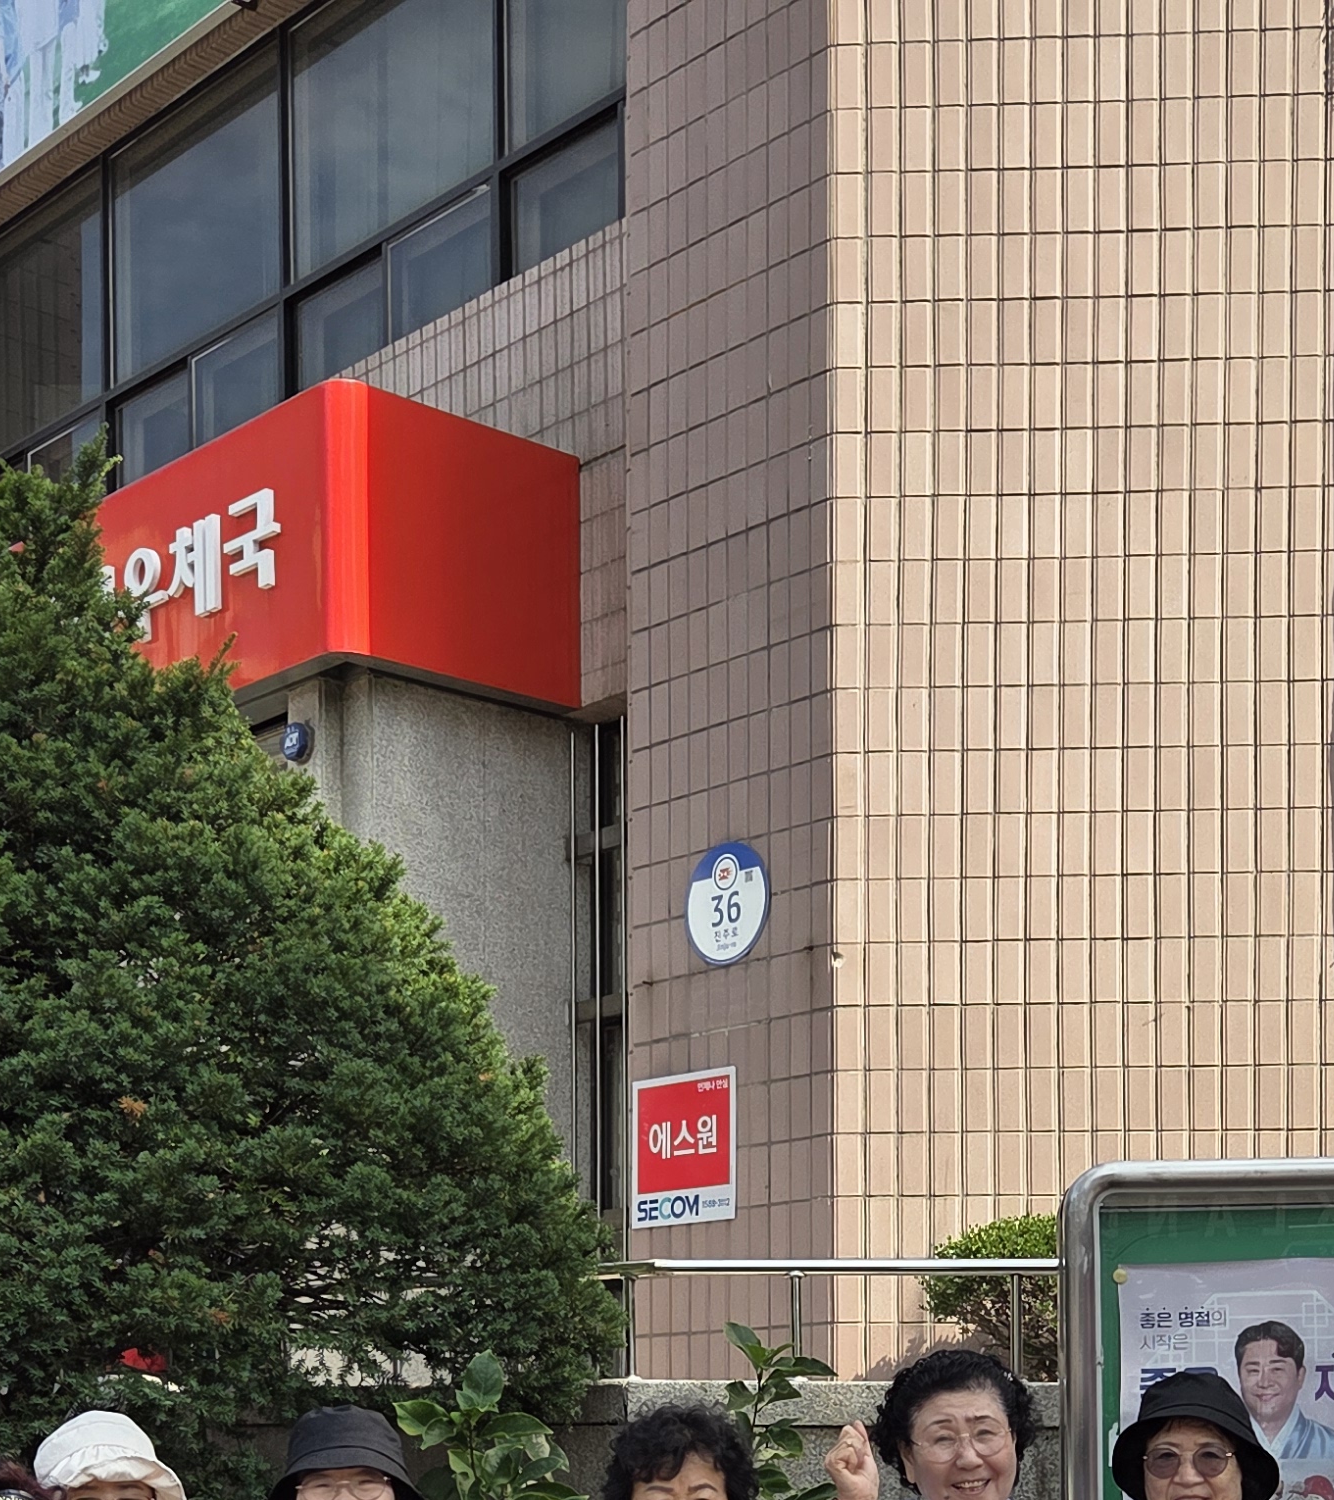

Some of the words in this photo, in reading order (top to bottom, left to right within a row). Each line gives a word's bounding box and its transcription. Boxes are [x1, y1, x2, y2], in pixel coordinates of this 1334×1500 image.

[102, 488, 281, 642] 우체국
[711, 890, 741, 928] 36
[714, 927, 739, 943] 진주로
[649, 1114, 717, 1160] 에스원
[637, 1194, 700, 1223] SECOM
[1139, 1310, 1172, 1328] 좋은
[1178, 1310, 1227, 1328] 명절의
[1140, 1333, 1189, 1351] 시작은
